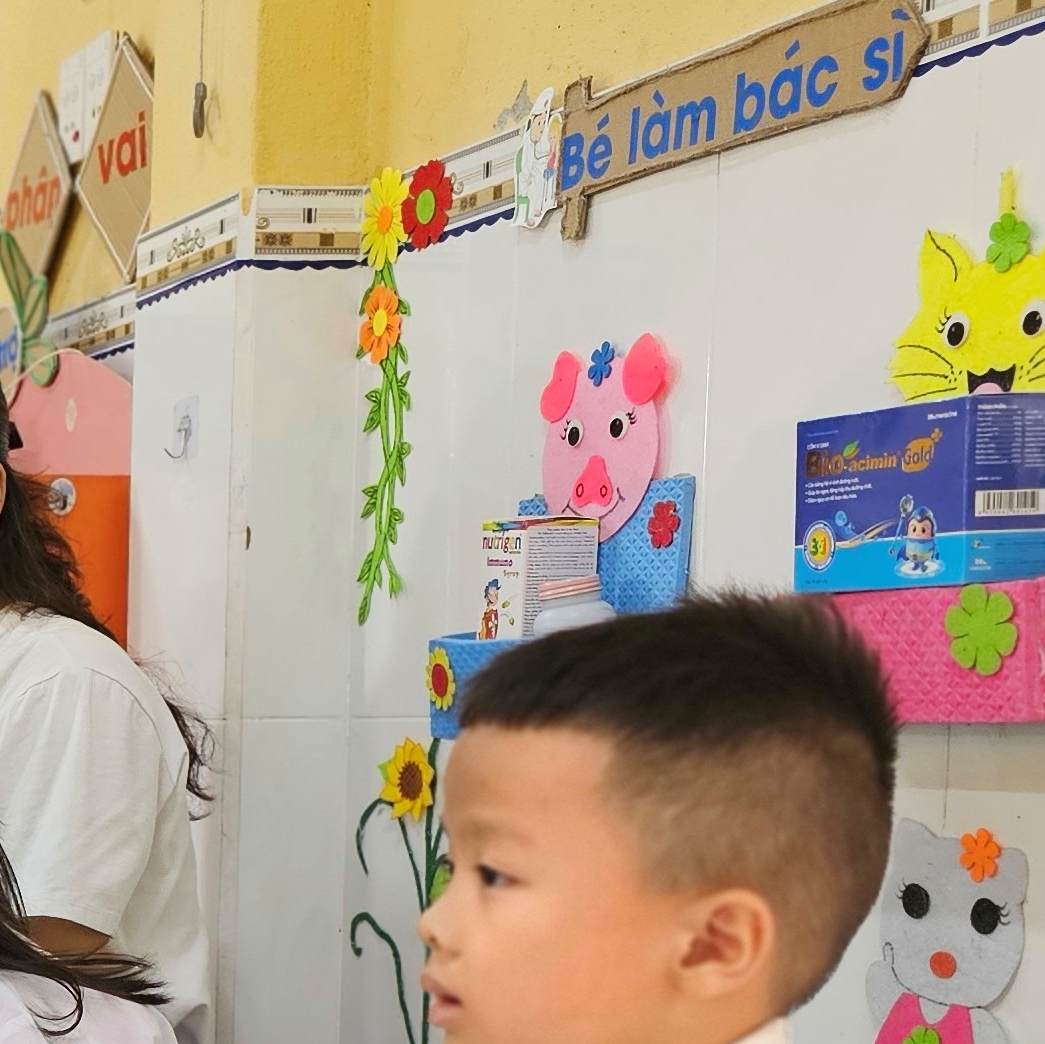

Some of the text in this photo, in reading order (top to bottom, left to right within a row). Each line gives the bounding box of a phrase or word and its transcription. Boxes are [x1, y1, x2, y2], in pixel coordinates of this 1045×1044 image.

[97, 110, 148, 185] vai
[561, 114, 612, 192] Bé
[628, 90, 716, 166] làm
[733, 39, 839, 134] bác
[6, 165, 61, 231] phân
